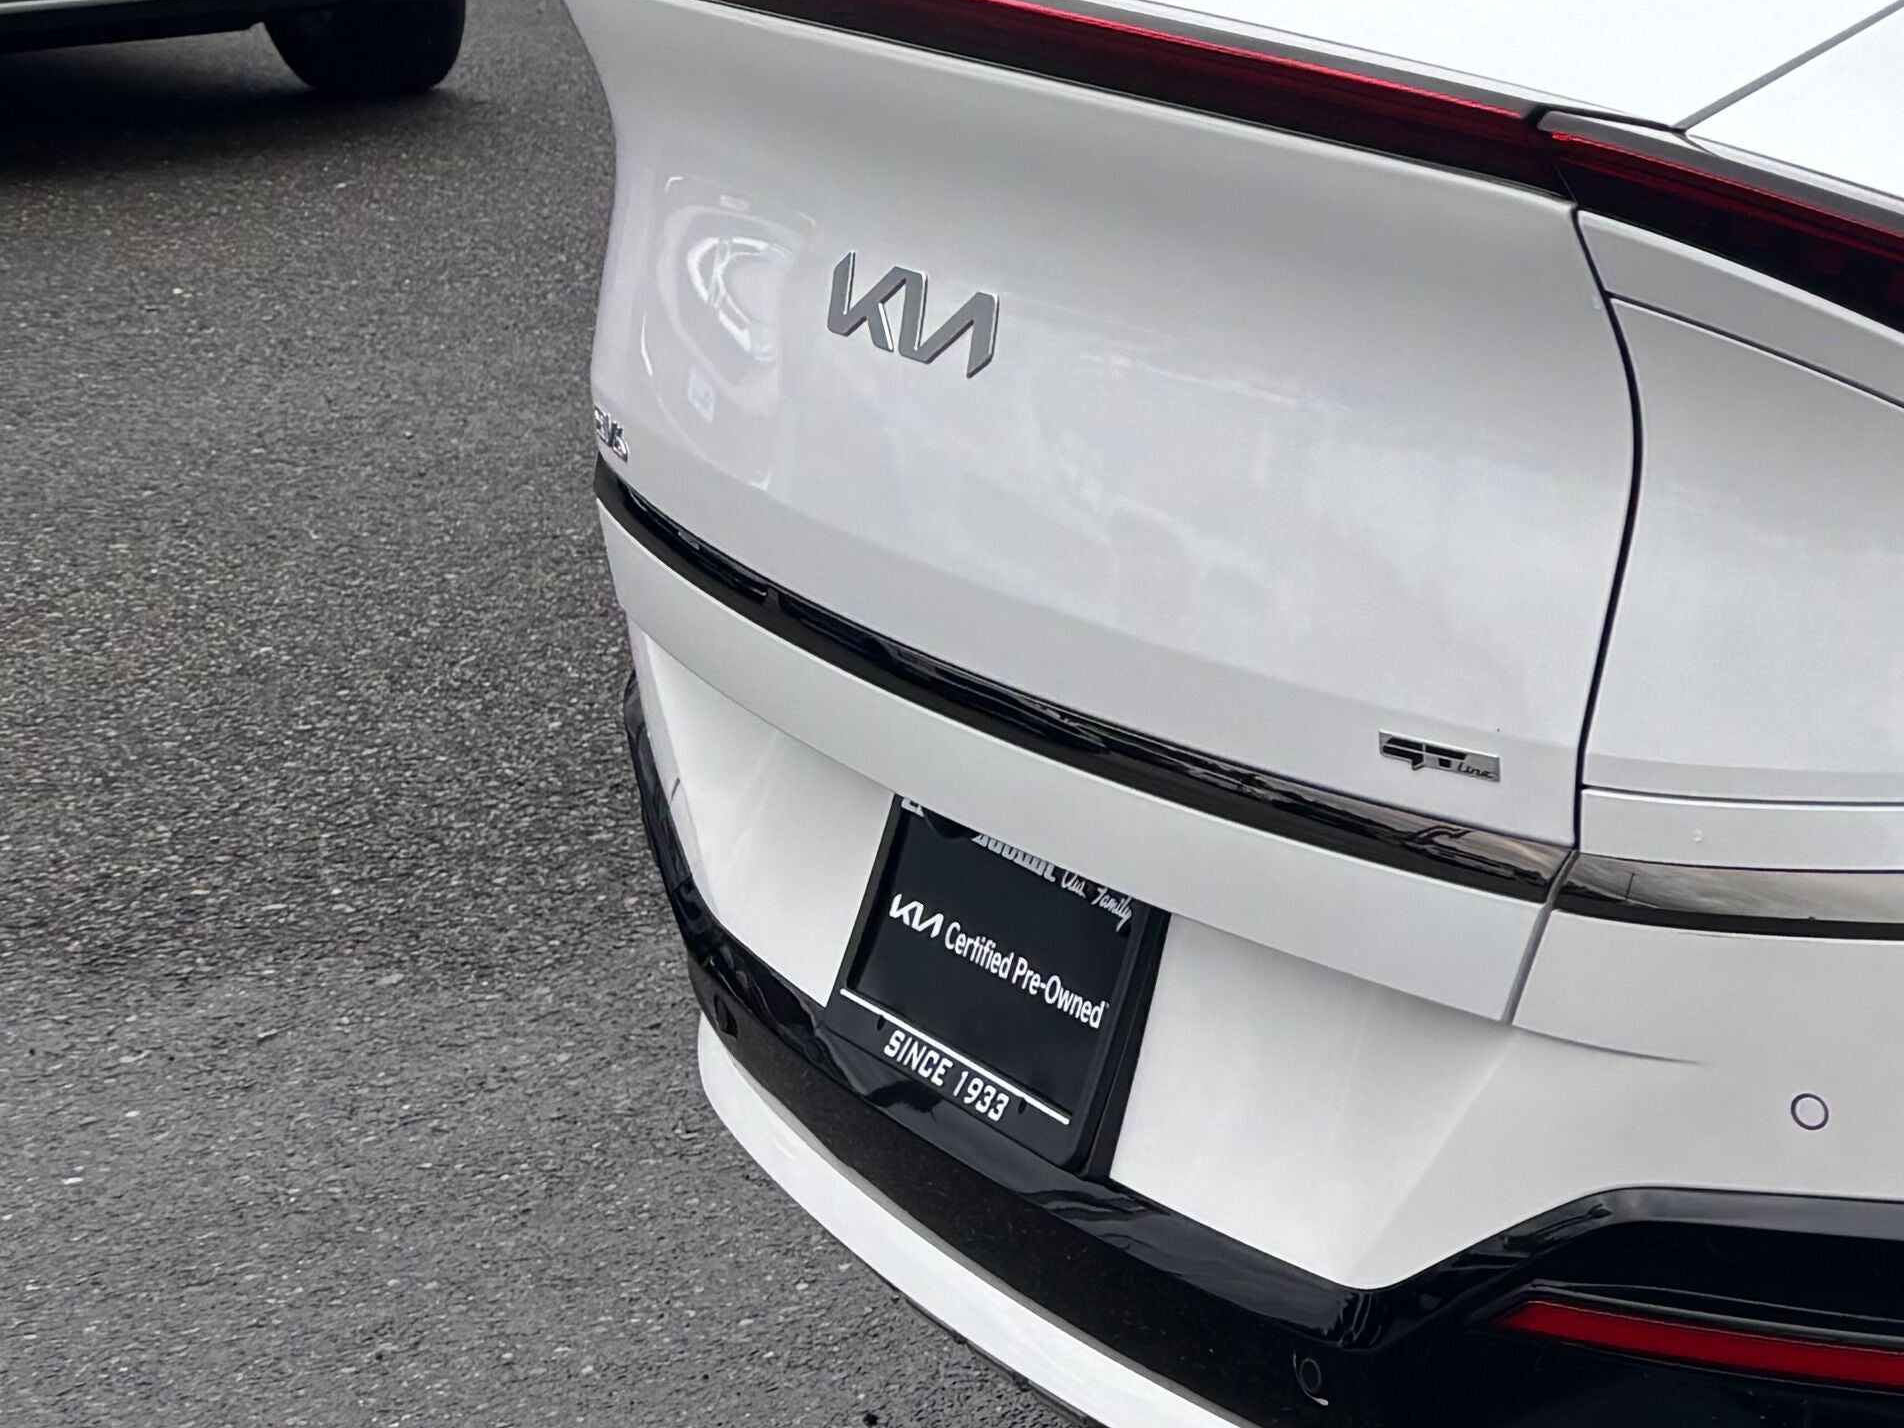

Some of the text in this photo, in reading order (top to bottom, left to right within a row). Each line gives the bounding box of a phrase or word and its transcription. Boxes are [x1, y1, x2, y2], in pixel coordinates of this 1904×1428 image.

[827, 249, 1000, 380] KIA
[888, 893, 1106, 1030] KIA Certified Pre-Owned
[883, 1030, 1010, 1122] SINCE 1933
